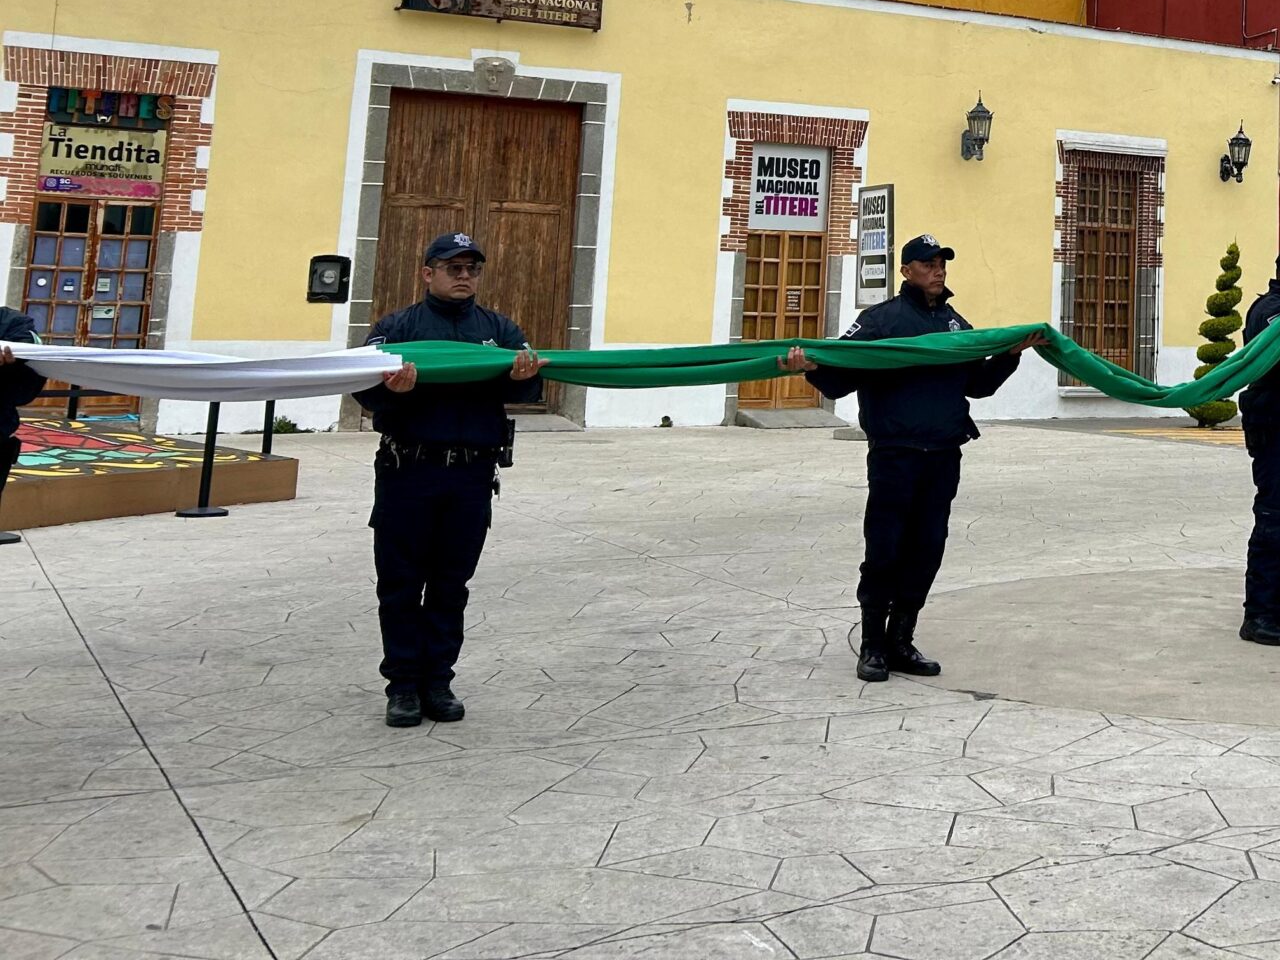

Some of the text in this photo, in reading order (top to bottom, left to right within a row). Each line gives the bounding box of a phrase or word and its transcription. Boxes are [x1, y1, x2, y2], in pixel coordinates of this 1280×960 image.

[510, 7, 533, 18] DEL
[49, 124, 67, 137] La
[48, 137, 160, 164] Tiendita
[757, 156, 821, 180] MUSEO
[108, 172, 153, 181] SOUVENIRS
[756, 179, 819, 196] NACIONAL
[755, 200, 764, 214] DEL
[764, 194, 819, 217] TÍTERE
[862, 195, 886, 216] MUSEO
[862, 216, 885, 230] NACIONAL
[865, 267, 884, 276] ENTRADA
